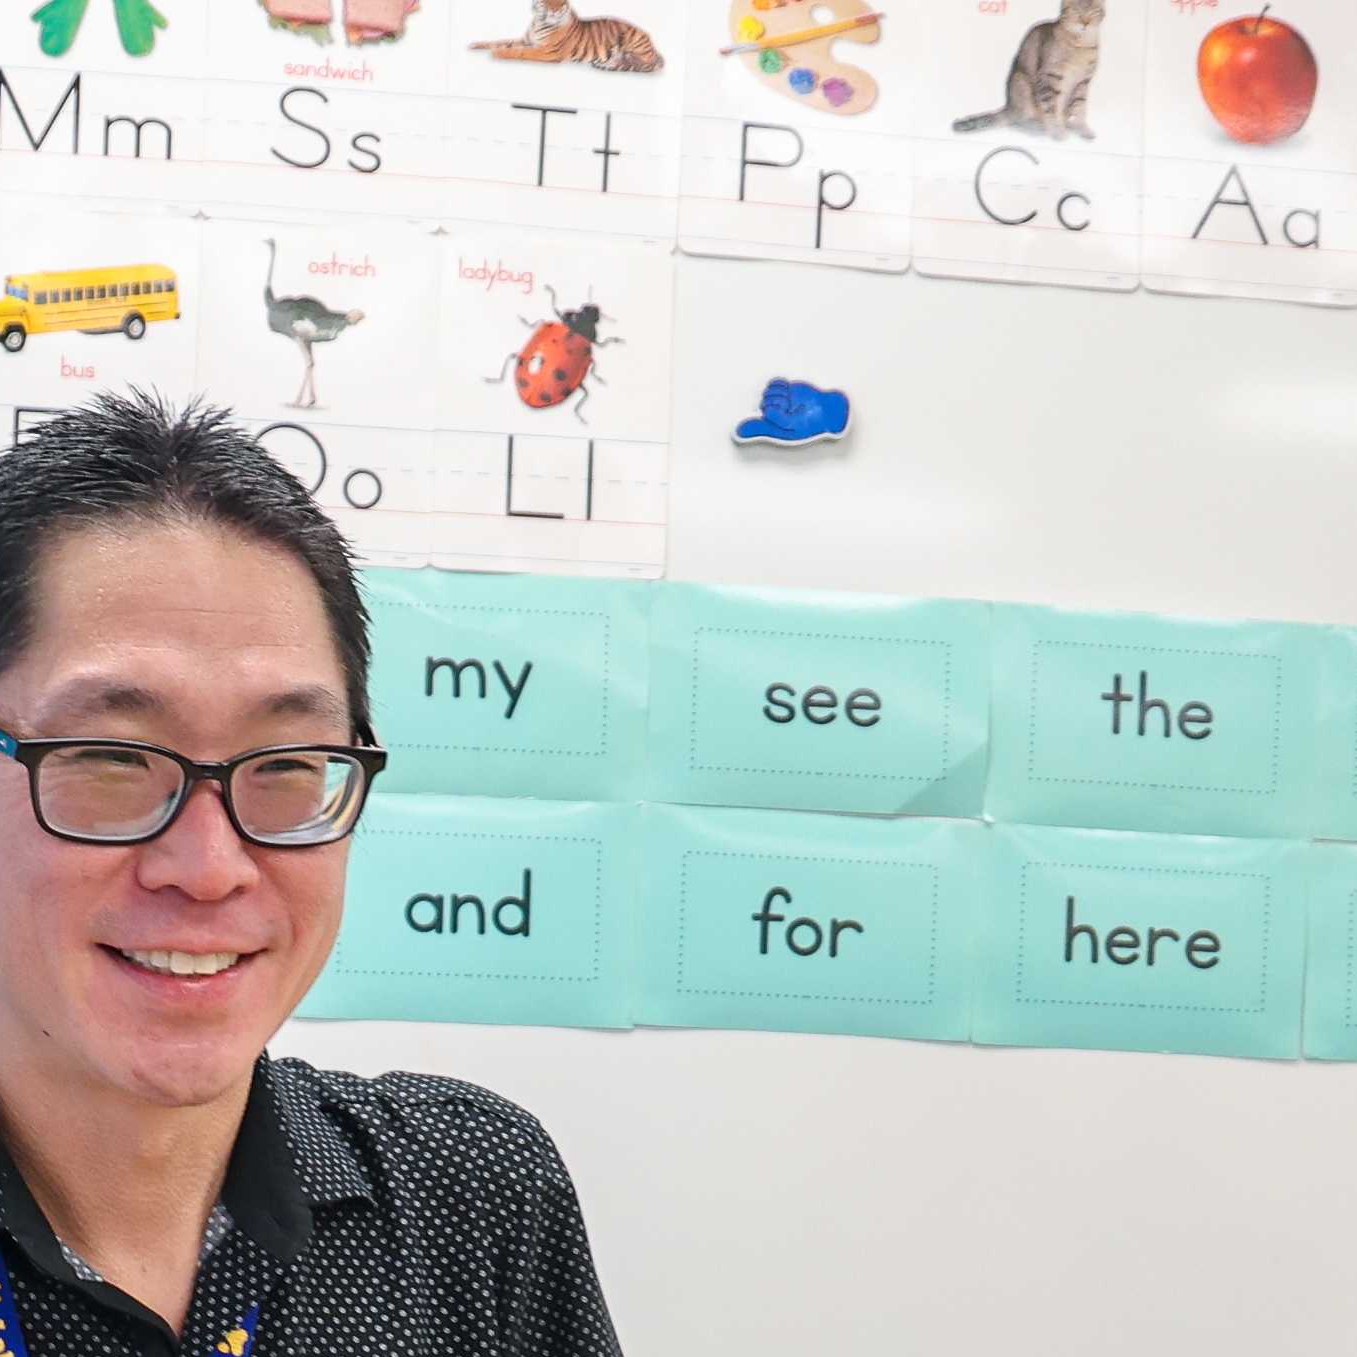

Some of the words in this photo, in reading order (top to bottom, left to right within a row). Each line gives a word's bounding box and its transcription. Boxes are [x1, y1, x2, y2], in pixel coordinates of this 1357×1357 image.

[283, 58, 375, 83] sandwich
[271, 86, 382, 174] Ss
[511, 103, 620, 193] Tt
[738, 122, 857, 250] Pp
[974, 147, 1090, 232] Cc
[1190, 166, 1320, 250] Aa
[308, 254, 378, 280] ostrich
[457, 257, 535, 296] ladybug
[59, 356, 96, 381] bus
[425, 657, 533, 720] my
[762, 684, 881, 728] see
[1101, 670, 1213, 741] the
[405, 868, 532, 938] and
[751, 886, 864, 959] for
[1064, 896, 1221, 970] here
